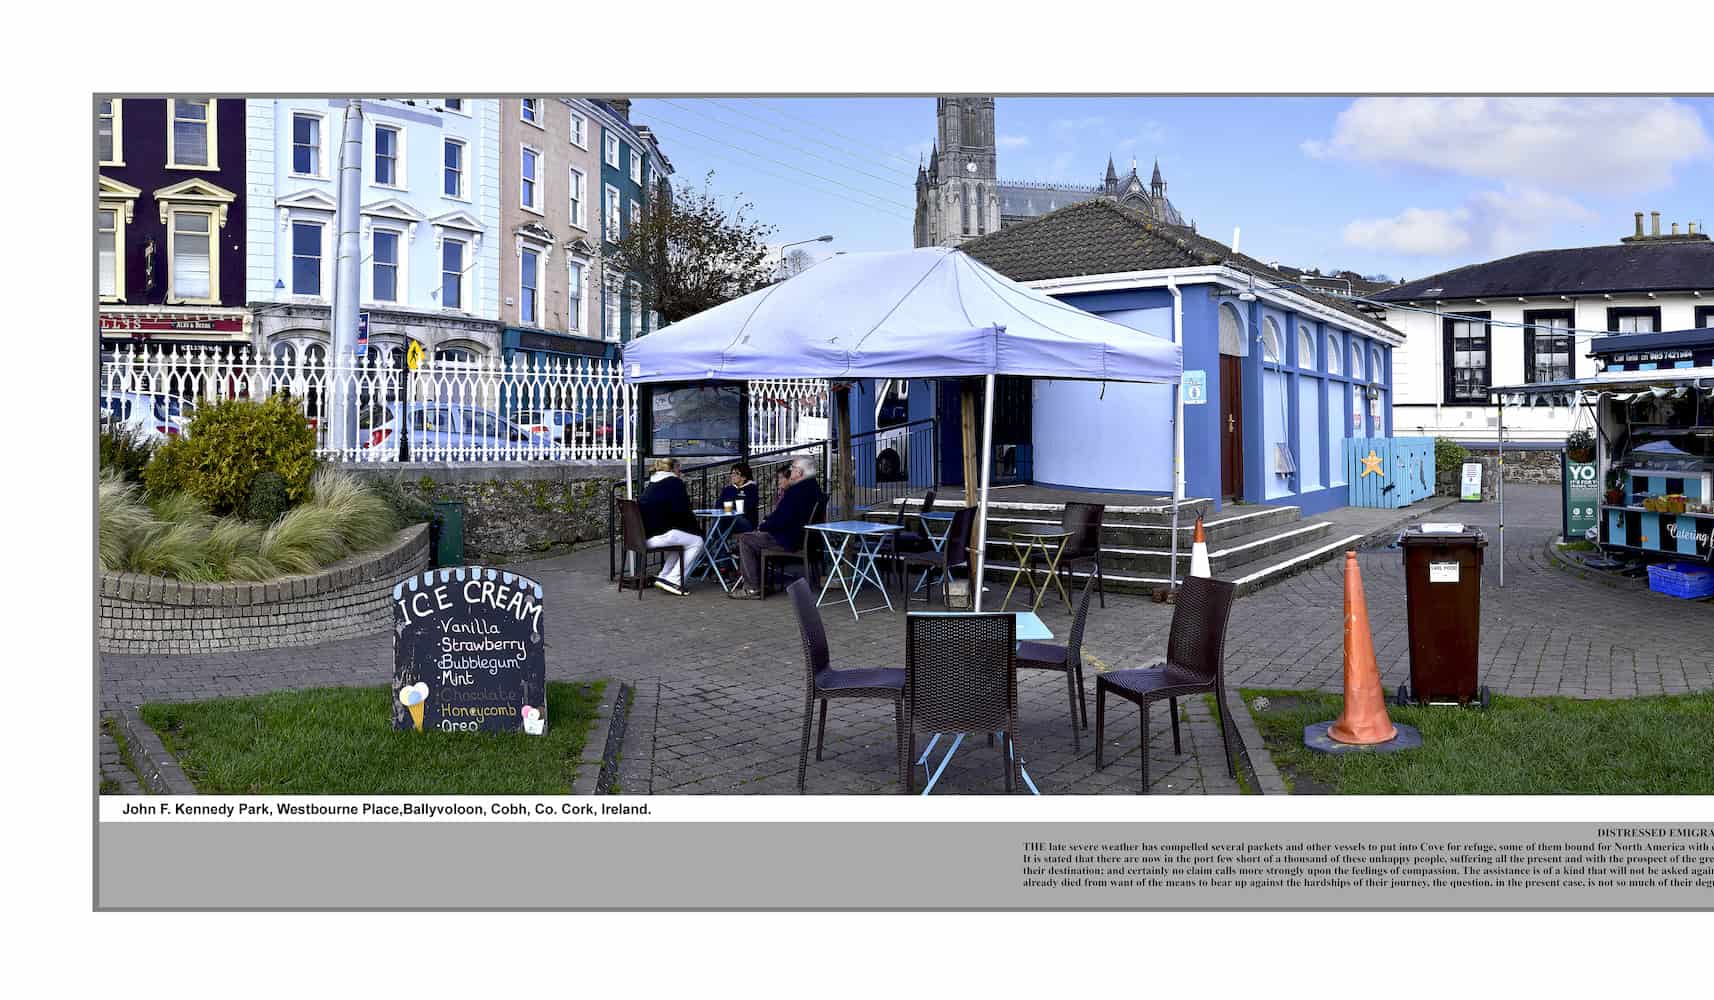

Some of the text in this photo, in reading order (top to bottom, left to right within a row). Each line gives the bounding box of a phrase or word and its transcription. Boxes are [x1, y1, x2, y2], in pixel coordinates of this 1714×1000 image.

[1569, 465, 1596, 480] YO
[399, 580, 543, 633] ICE CREAM
[440, 617, 500, 634] Vanilla
[441, 637, 527, 661] Strawberry
[437, 654, 521, 675] Bubblegum
[441, 671, 475, 686] Mint
[440, 688, 517, 701] Chocolate
[441, 703, 517, 723] Honeycomb
[441, 720, 479, 732] Oreo
